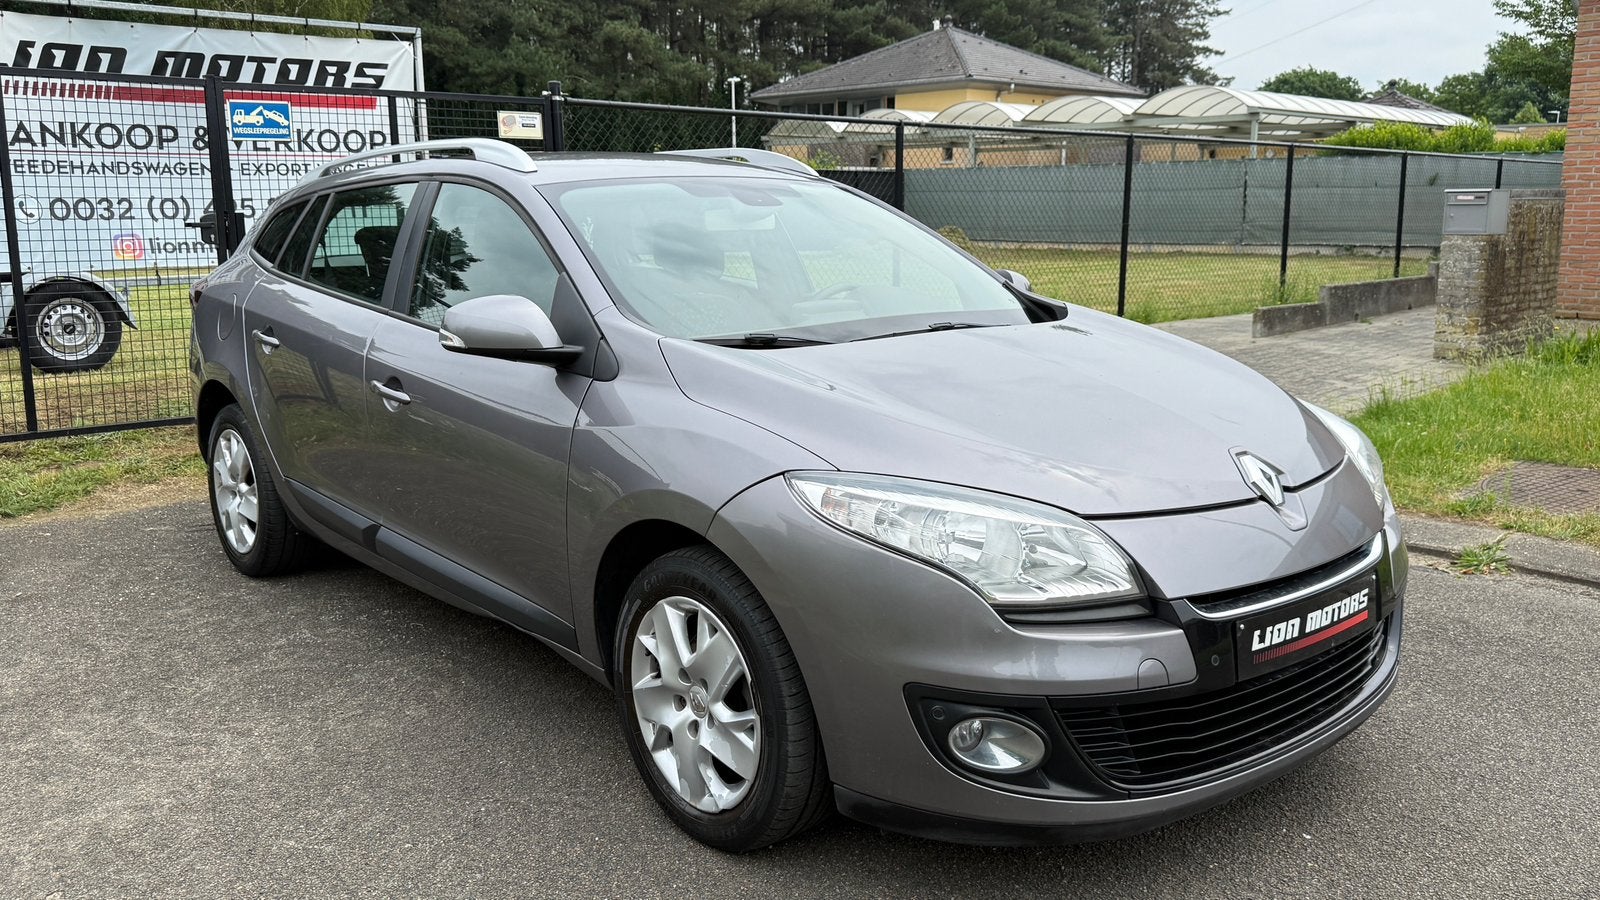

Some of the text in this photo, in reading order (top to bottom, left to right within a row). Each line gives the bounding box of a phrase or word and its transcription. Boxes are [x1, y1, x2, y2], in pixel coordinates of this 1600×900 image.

[0, 40, 389, 89] ION MOTORS
[233, 126, 290, 135] WEGSLEEPREGELING
[10, 159, 211, 177] EEDEHANDSWAGEN
[241, 162, 311, 176] EXPORT
[50, 197, 136, 221] 0032
[147, 195, 190, 222] (0)
[149, 237, 219, 254] lionm
[1251, 588, 1369, 651] LION MOTORS
